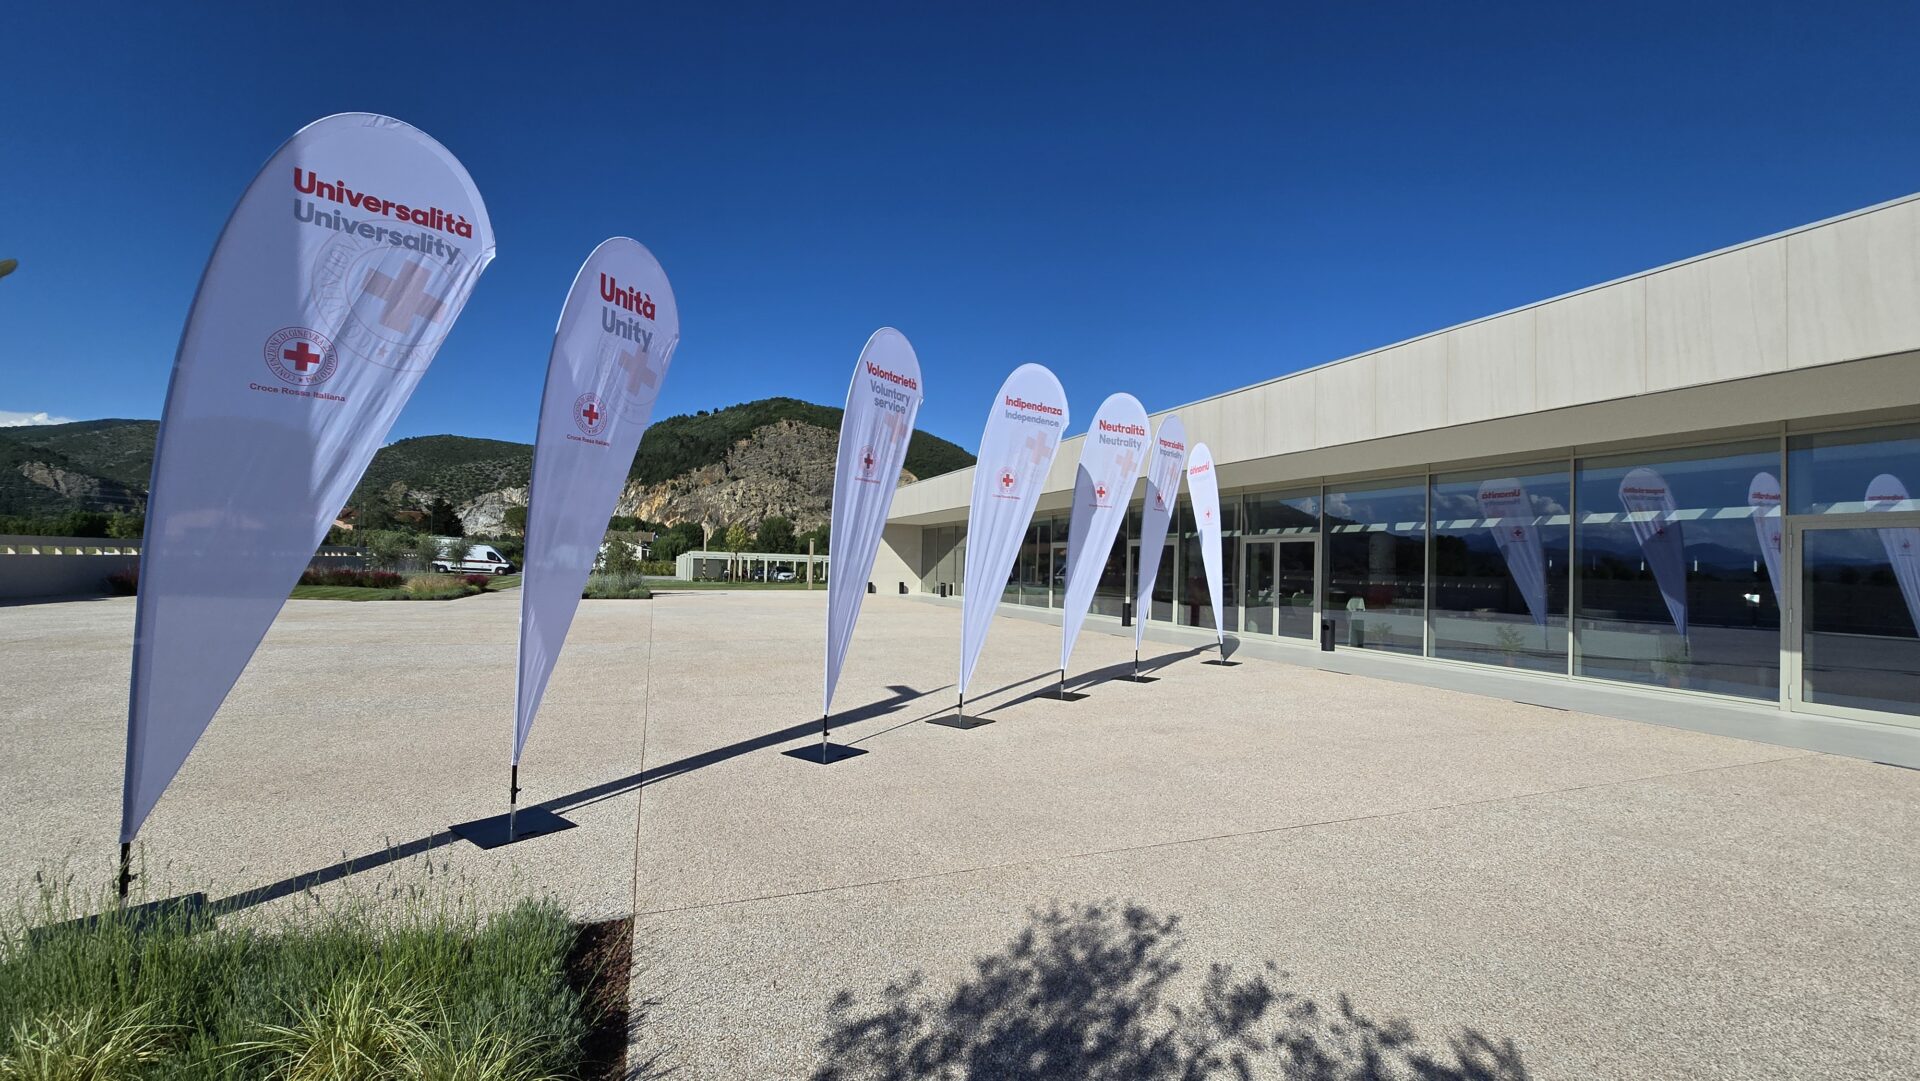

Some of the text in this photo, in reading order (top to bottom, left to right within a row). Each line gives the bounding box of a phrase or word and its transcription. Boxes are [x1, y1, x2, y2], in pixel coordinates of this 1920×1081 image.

[294, 167, 472, 239] Universalità
[294, 198, 461, 265] Universality
[600, 272, 655, 321] Unità
[602, 306, 653, 353] Unity
[866, 361, 917, 390] Volontarietà
[249, 382, 345, 402] Croce Rossa Italiana
[870, 379, 910, 407] Voluntary
[874, 397, 906, 414] service
[1005, 395, 1062, 416] Indipendenza
[1005, 410, 1059, 427] Independence
[1099, 419, 1145, 436] Neutralità
[1099, 434, 1141, 451] Neutrality
